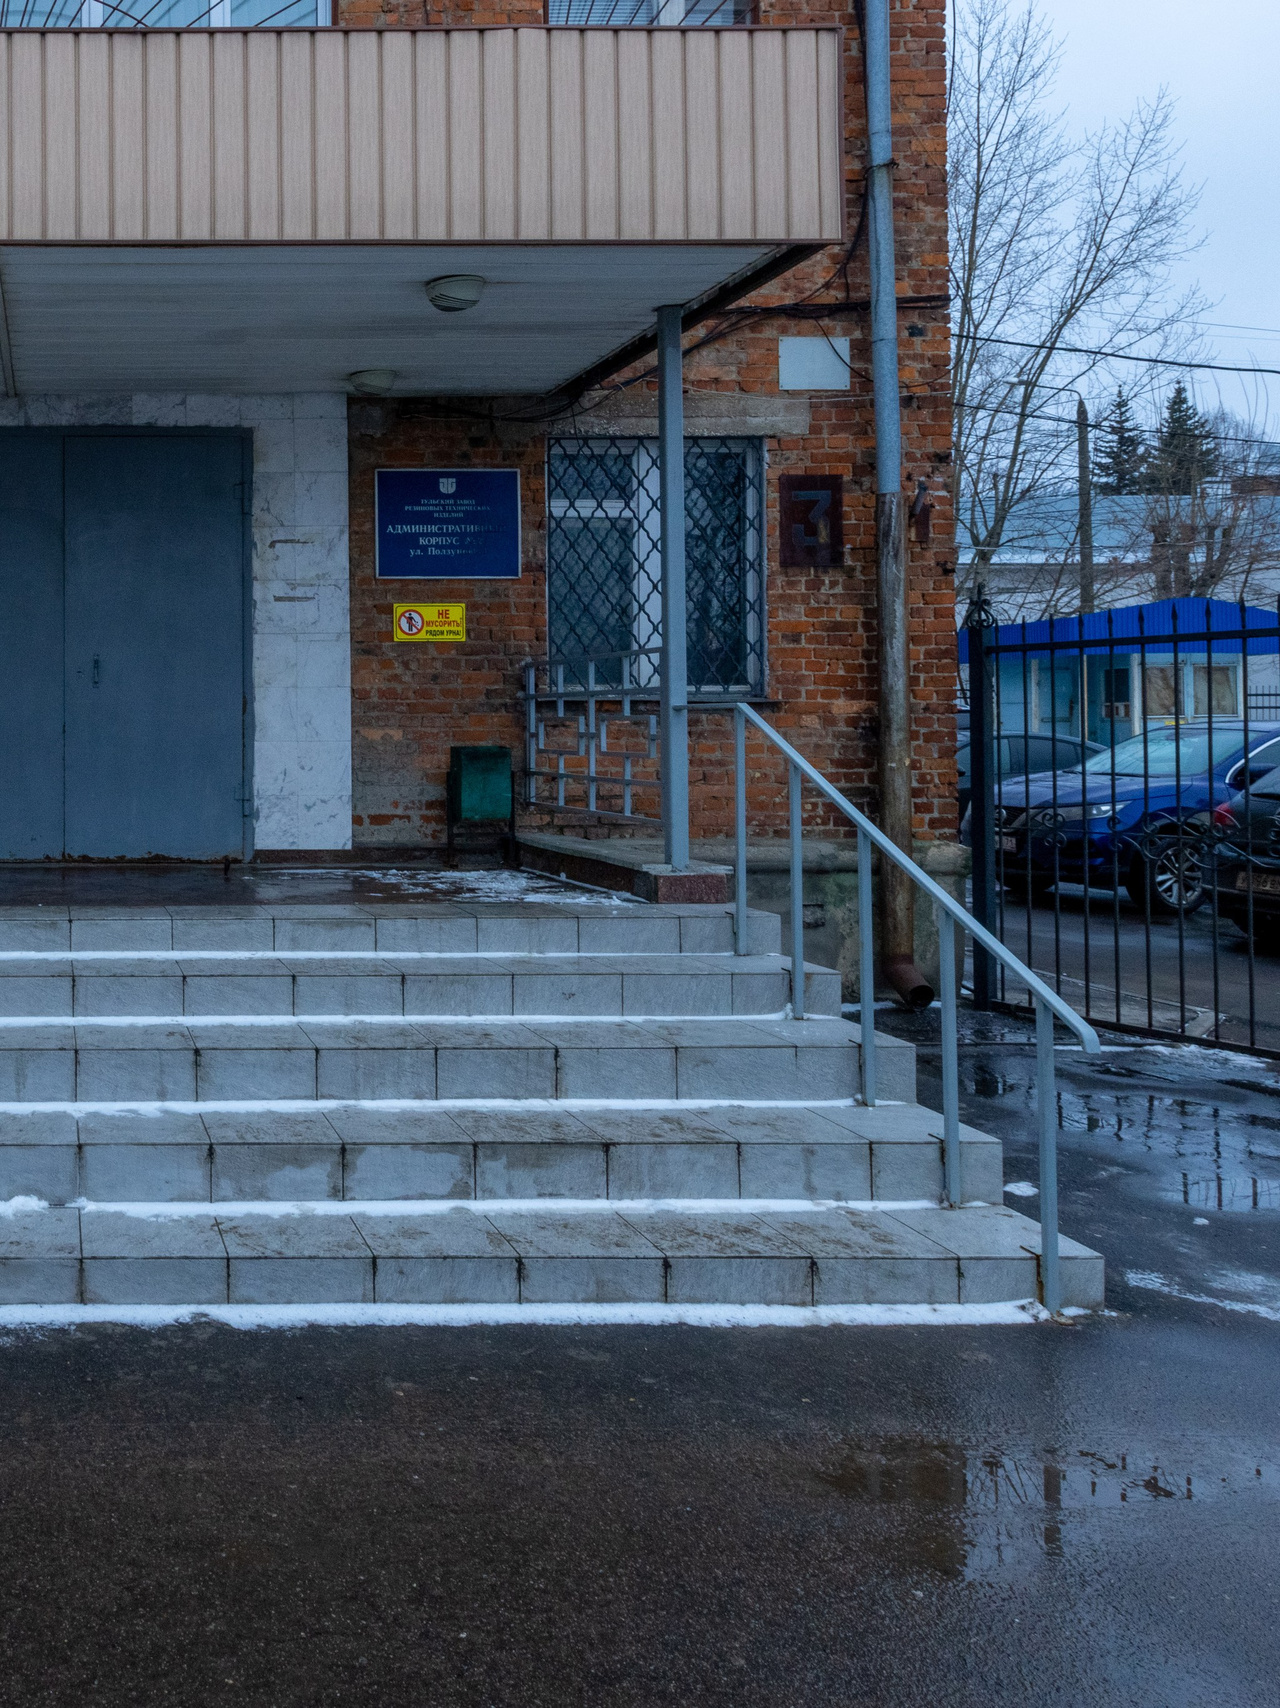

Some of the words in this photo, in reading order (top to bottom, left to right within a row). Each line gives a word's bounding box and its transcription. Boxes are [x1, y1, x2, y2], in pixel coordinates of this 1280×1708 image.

[792, 490, 832, 546] 3
[386, 524, 504, 534] АДМИНИСТРАТИВ
[419, 536, 460, 545] КОРПУС
[437, 609, 450, 619] НЕ
[425, 629, 445, 637] РЯДОМ
